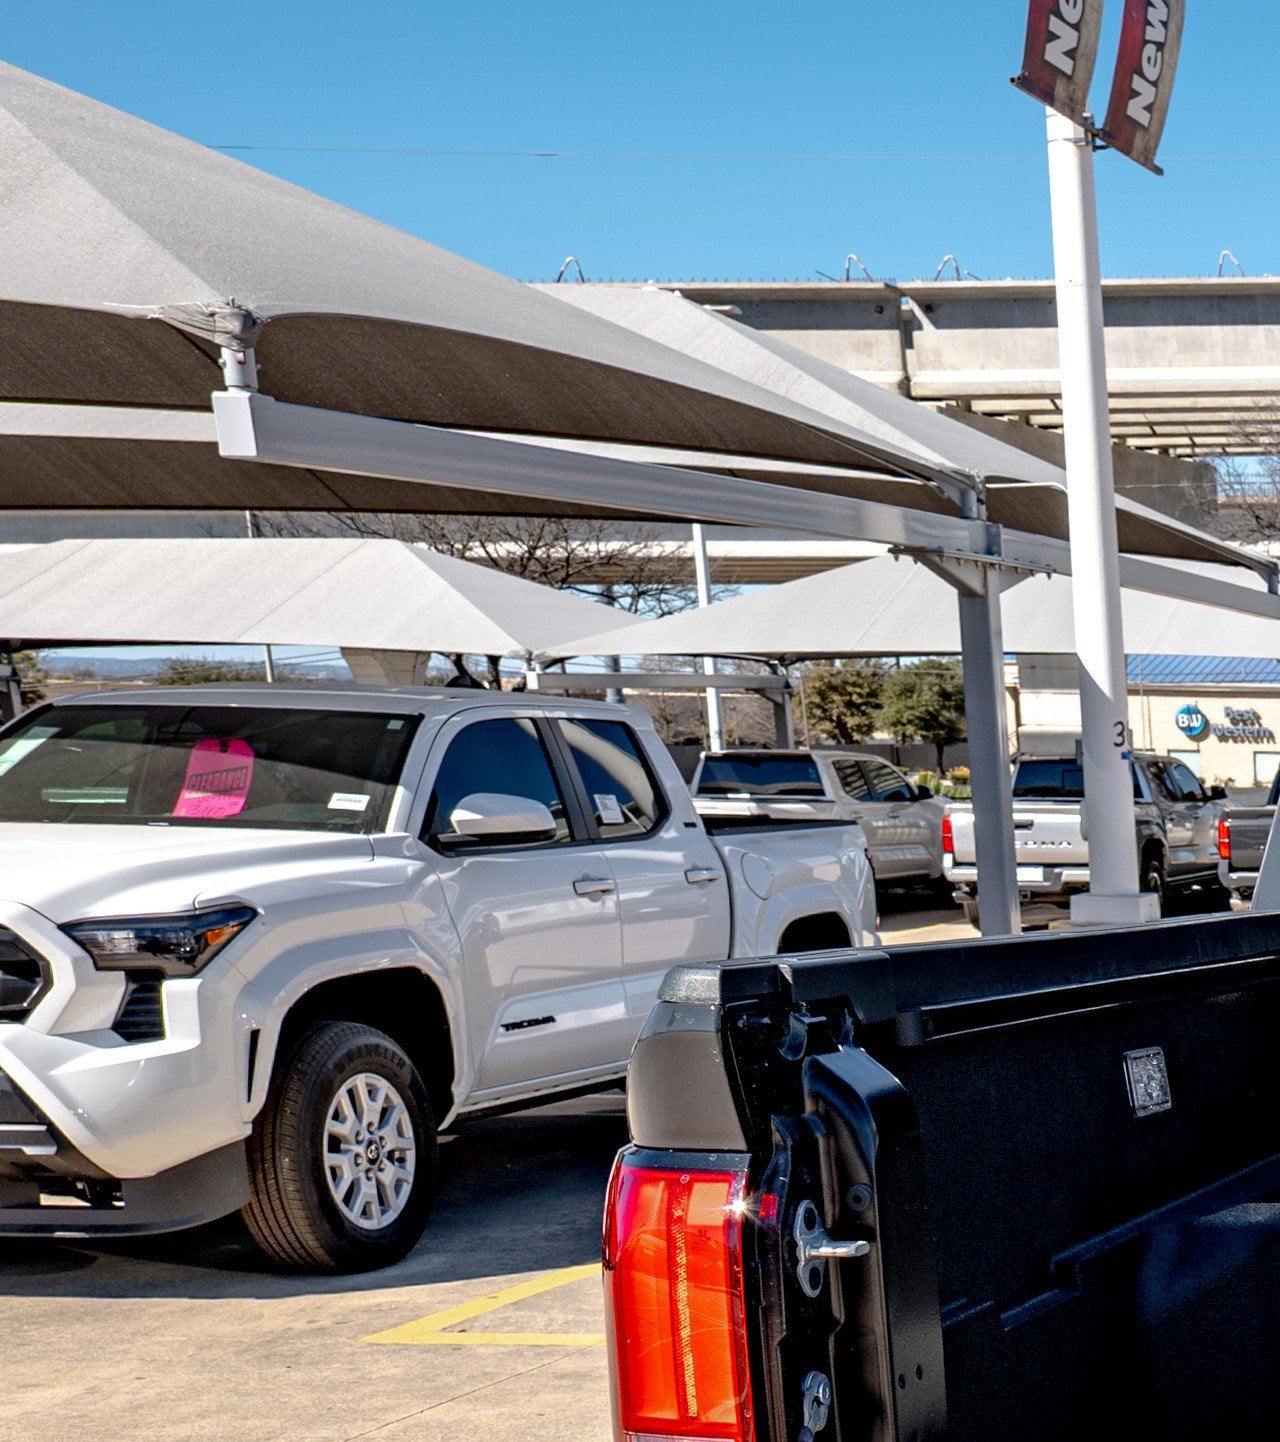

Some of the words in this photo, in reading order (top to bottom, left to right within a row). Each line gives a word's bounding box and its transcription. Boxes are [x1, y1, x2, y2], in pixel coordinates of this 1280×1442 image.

[1043, 0, 1085, 76] Ne
[1125, 0, 1169, 128] New
[1177, 713, 1202, 728] BW
[1223, 706, 1256, 719] Best
[1112, 720, 1126, 748] 3
[1209, 723, 1271, 737] Western
